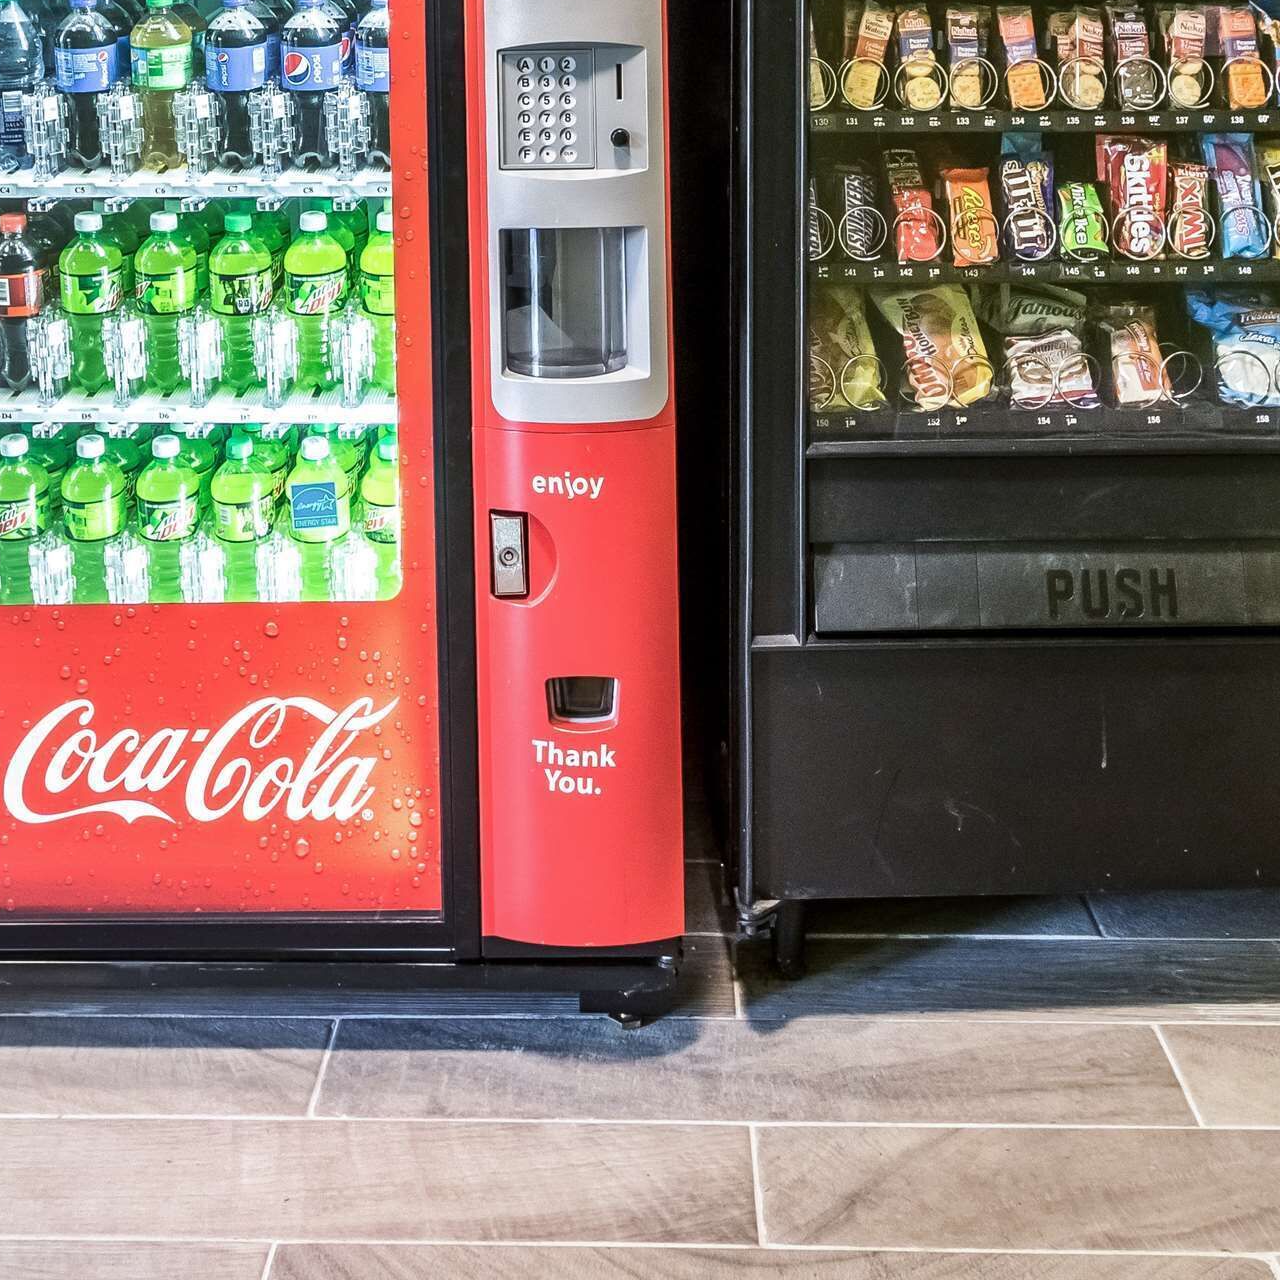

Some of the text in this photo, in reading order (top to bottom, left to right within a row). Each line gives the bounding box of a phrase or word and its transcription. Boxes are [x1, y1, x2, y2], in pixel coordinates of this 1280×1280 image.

[1118, 24, 1146, 34] Nekot
[521, 61, 529, 70] A
[544, 60, 548, 69] 1
[564, 60, 570, 69] 2
[522, 78, 530, 87] B
[544, 78, 550, 87] 3
[564, 78, 570, 87] 4
[522, 96, 530, 105] C
[544, 96, 550, 105] 5
[564, 96, 570, 105] 6
[522, 114, 530, 123] D
[544, 114, 550, 123] 7
[564, 114, 571, 123] 8
[814, 118, 828, 126] 130
[1012, 117, 1024, 125] 134
[1067, 117, 1080, 125] 135
[1122, 116, 1134, 124] 136
[1176, 116, 1188, 124] 137
[1231, 116, 1244, 124] 138
[523, 132, 530, 141] E
[544, 132, 551, 141] 9
[565, 132, 572, 141] 0
[524, 150, 530, 159] F
[0, 186, 10, 194] C4
[74, 186, 85, 194] C5
[155, 186, 166, 194] C6
[303, 186, 314, 194] C8
[377, 186, 388, 194] C9
[844, 268, 856, 276] 141
[900, 268, 913, 276] 142
[965, 269, 978, 277] 143
[1022, 268, 1036, 276] 144
[1007, 299, 1085, 322] Famous
[2, 412, 12, 420] D4
[81, 412, 92, 420] D5
[158, 412, 169, 420] D6
[816, 419, 829, 427] 150
[928, 418, 940, 426] 152
[531, 472, 604, 499] enjoy
[295, 518, 338, 528] ENERGY STAR
[1046, 567, 1180, 618] PUSH
[531, 740, 616, 768] Thank
[3, 696, 400, 824] Coca-Cola
[545, 768, 601, 795] You.
